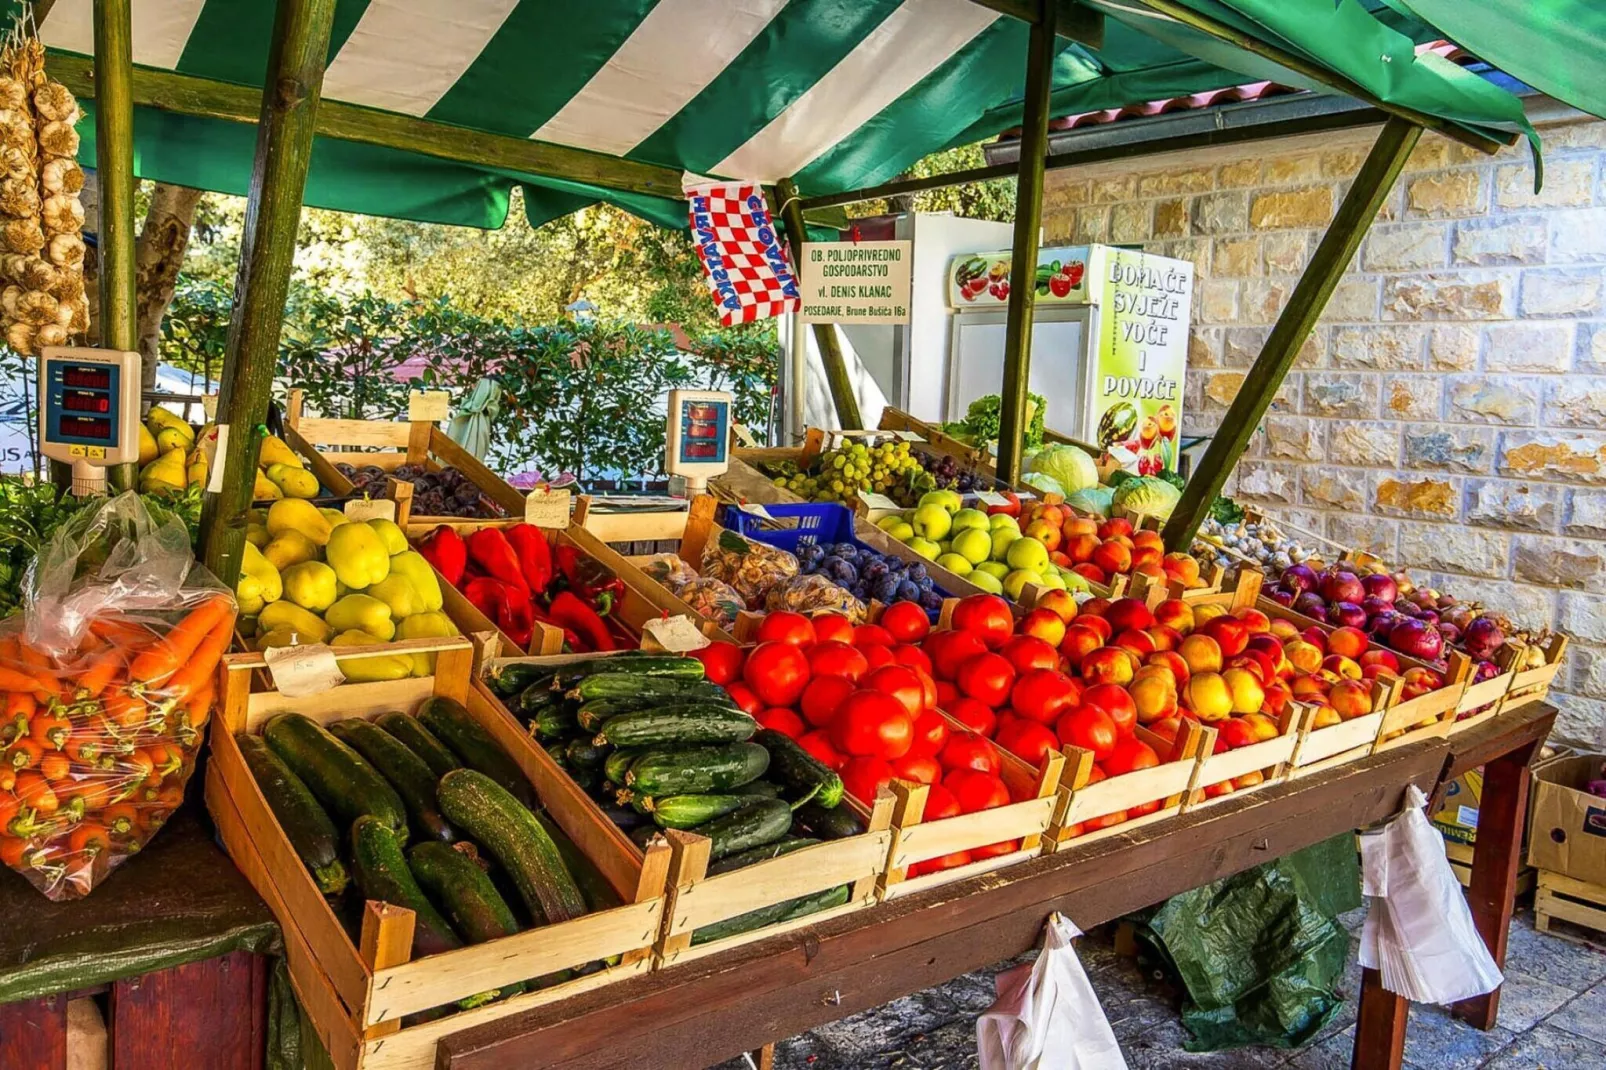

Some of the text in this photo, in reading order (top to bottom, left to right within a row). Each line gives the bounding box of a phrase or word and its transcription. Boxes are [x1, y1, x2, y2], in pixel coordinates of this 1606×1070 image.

[811, 249, 901, 262] OB. POLJOPRIVREDNO
[823, 264, 888, 277] GOSPODARSTVO
[831, 286, 856, 298] DENIS
[859, 285, 892, 298] KLANAC
[1114, 291, 1179, 320] SVJEŽE
[1121, 319, 1168, 346] VOĆE
[1138, 350, 1146, 372] I
[1103, 374, 1177, 400] POVRĆE
